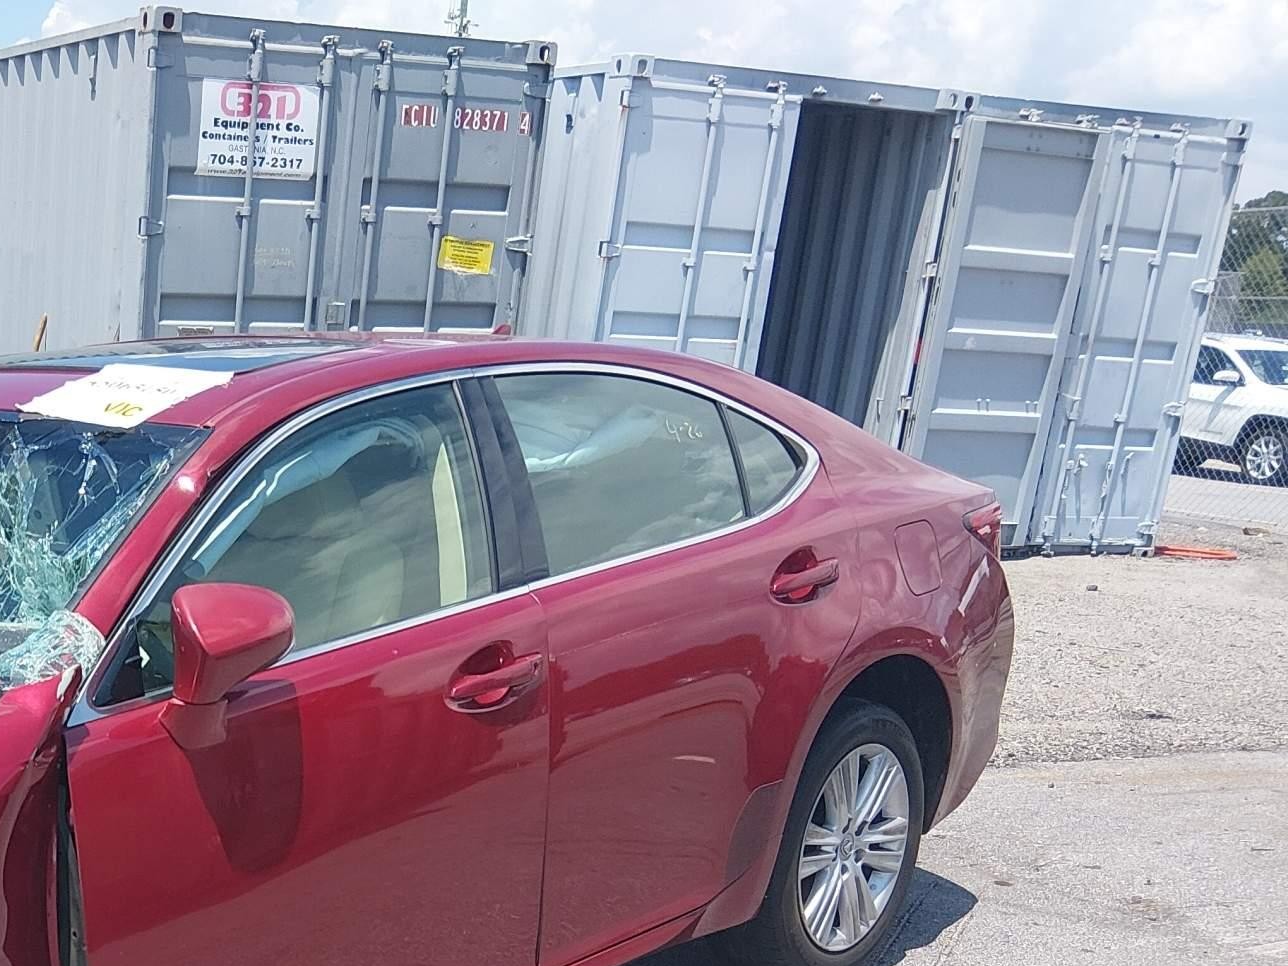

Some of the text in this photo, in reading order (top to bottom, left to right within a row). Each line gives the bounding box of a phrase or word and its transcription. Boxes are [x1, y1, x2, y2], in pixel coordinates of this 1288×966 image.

[285, 122, 304, 133] Co.
[453, 107, 509, 132] 828371
[520, 112, 530, 134] 4
[201, 130, 261, 144] Containes
[272, 135, 314, 146] Trailers
[103, 402, 144, 417] VIC
